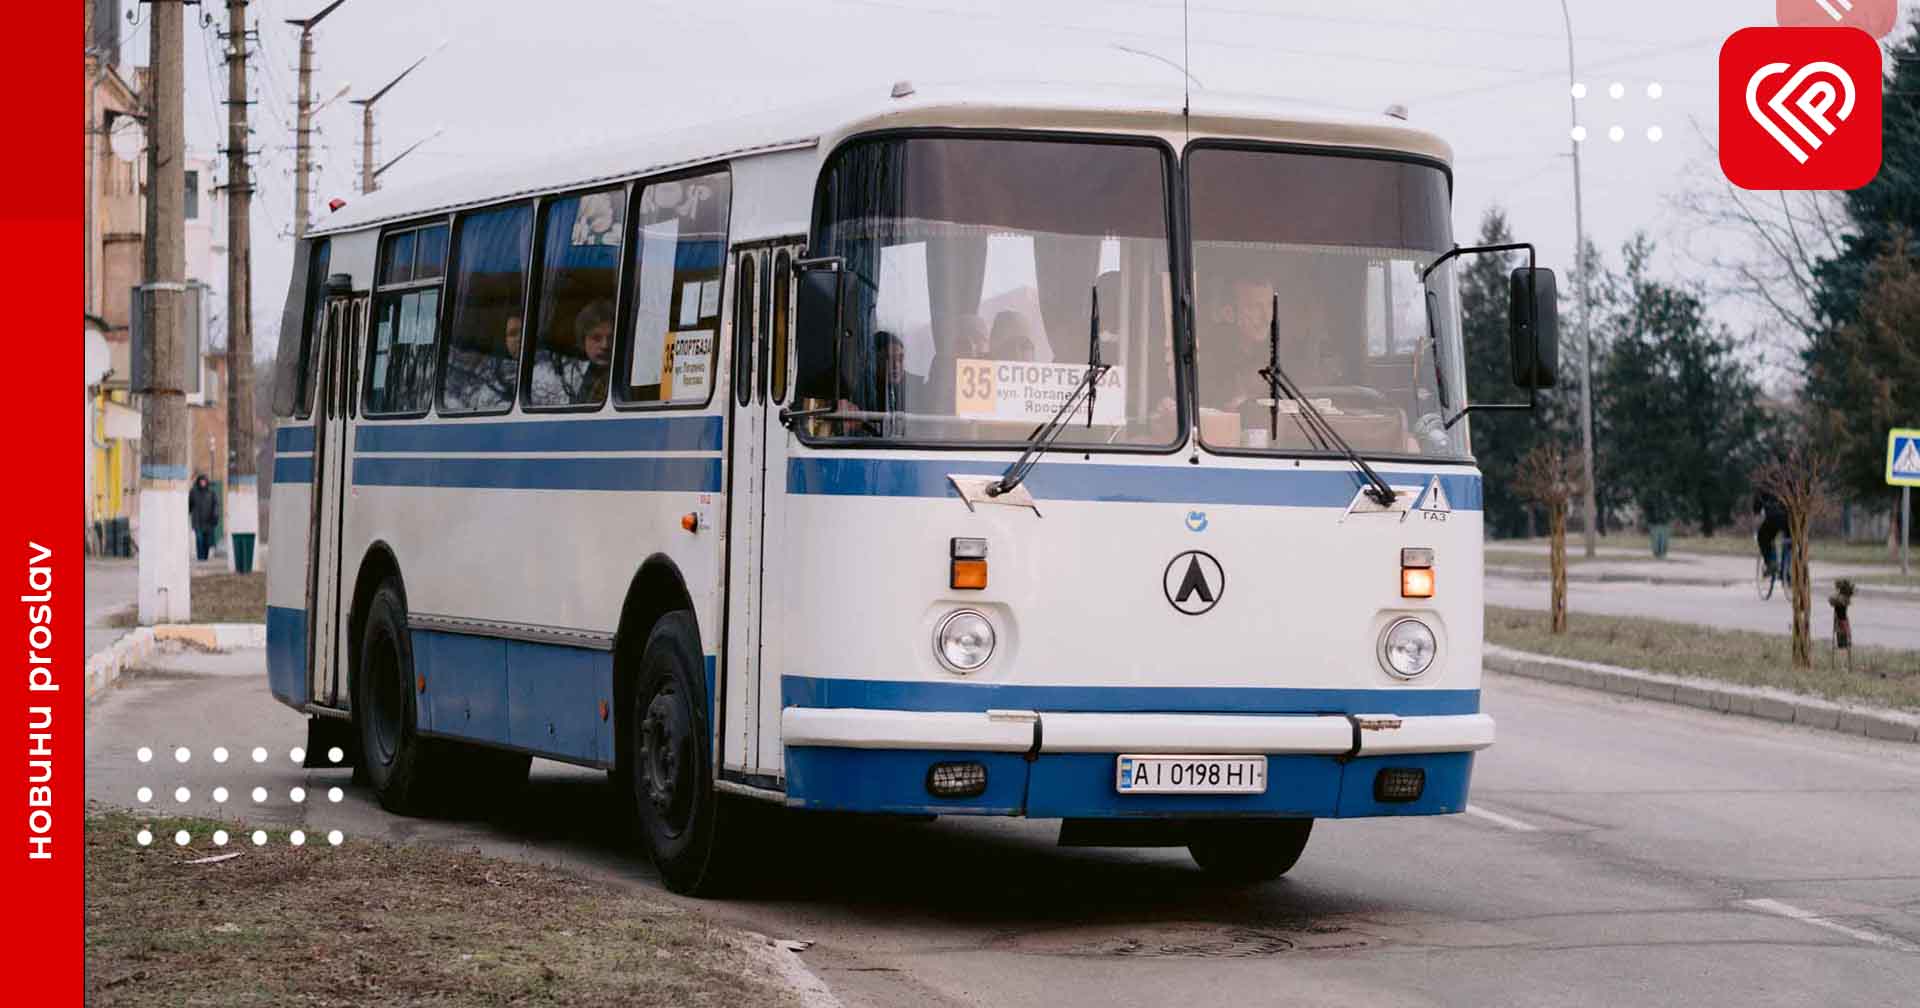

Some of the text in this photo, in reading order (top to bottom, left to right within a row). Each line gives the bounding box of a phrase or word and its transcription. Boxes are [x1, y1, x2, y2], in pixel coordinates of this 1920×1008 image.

[961, 366, 992, 399] 35
[998, 365, 1120, 388] СПОРТБА
[1423, 512, 1447, 521] ГАЗ
[1171, 763, 1220, 785] 0198
